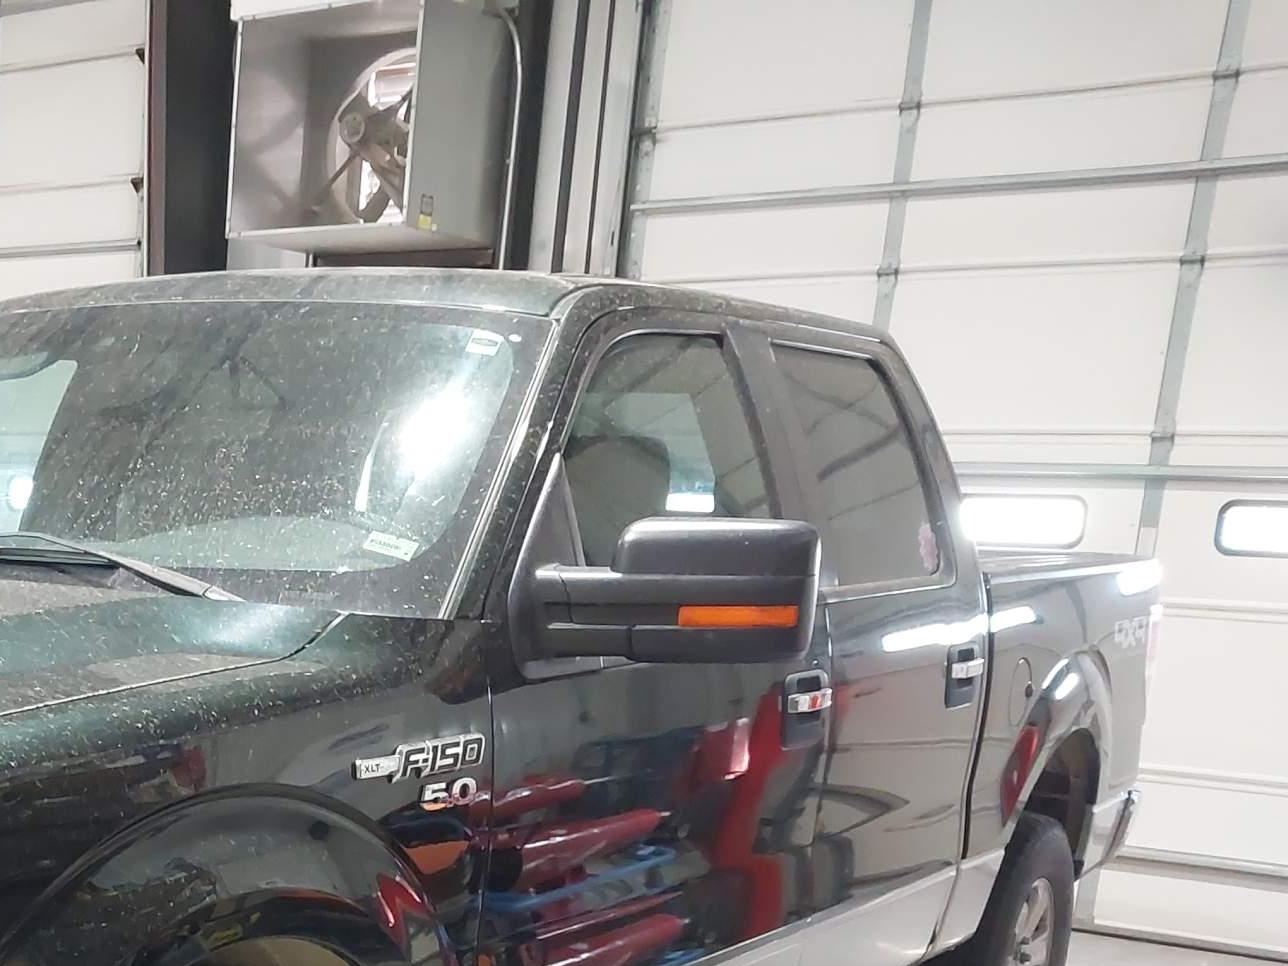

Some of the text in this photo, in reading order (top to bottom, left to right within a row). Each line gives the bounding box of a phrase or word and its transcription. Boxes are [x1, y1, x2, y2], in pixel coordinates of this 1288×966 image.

[364, 736, 484, 779] XLT F-150
[420, 778, 477, 811] 5.0
